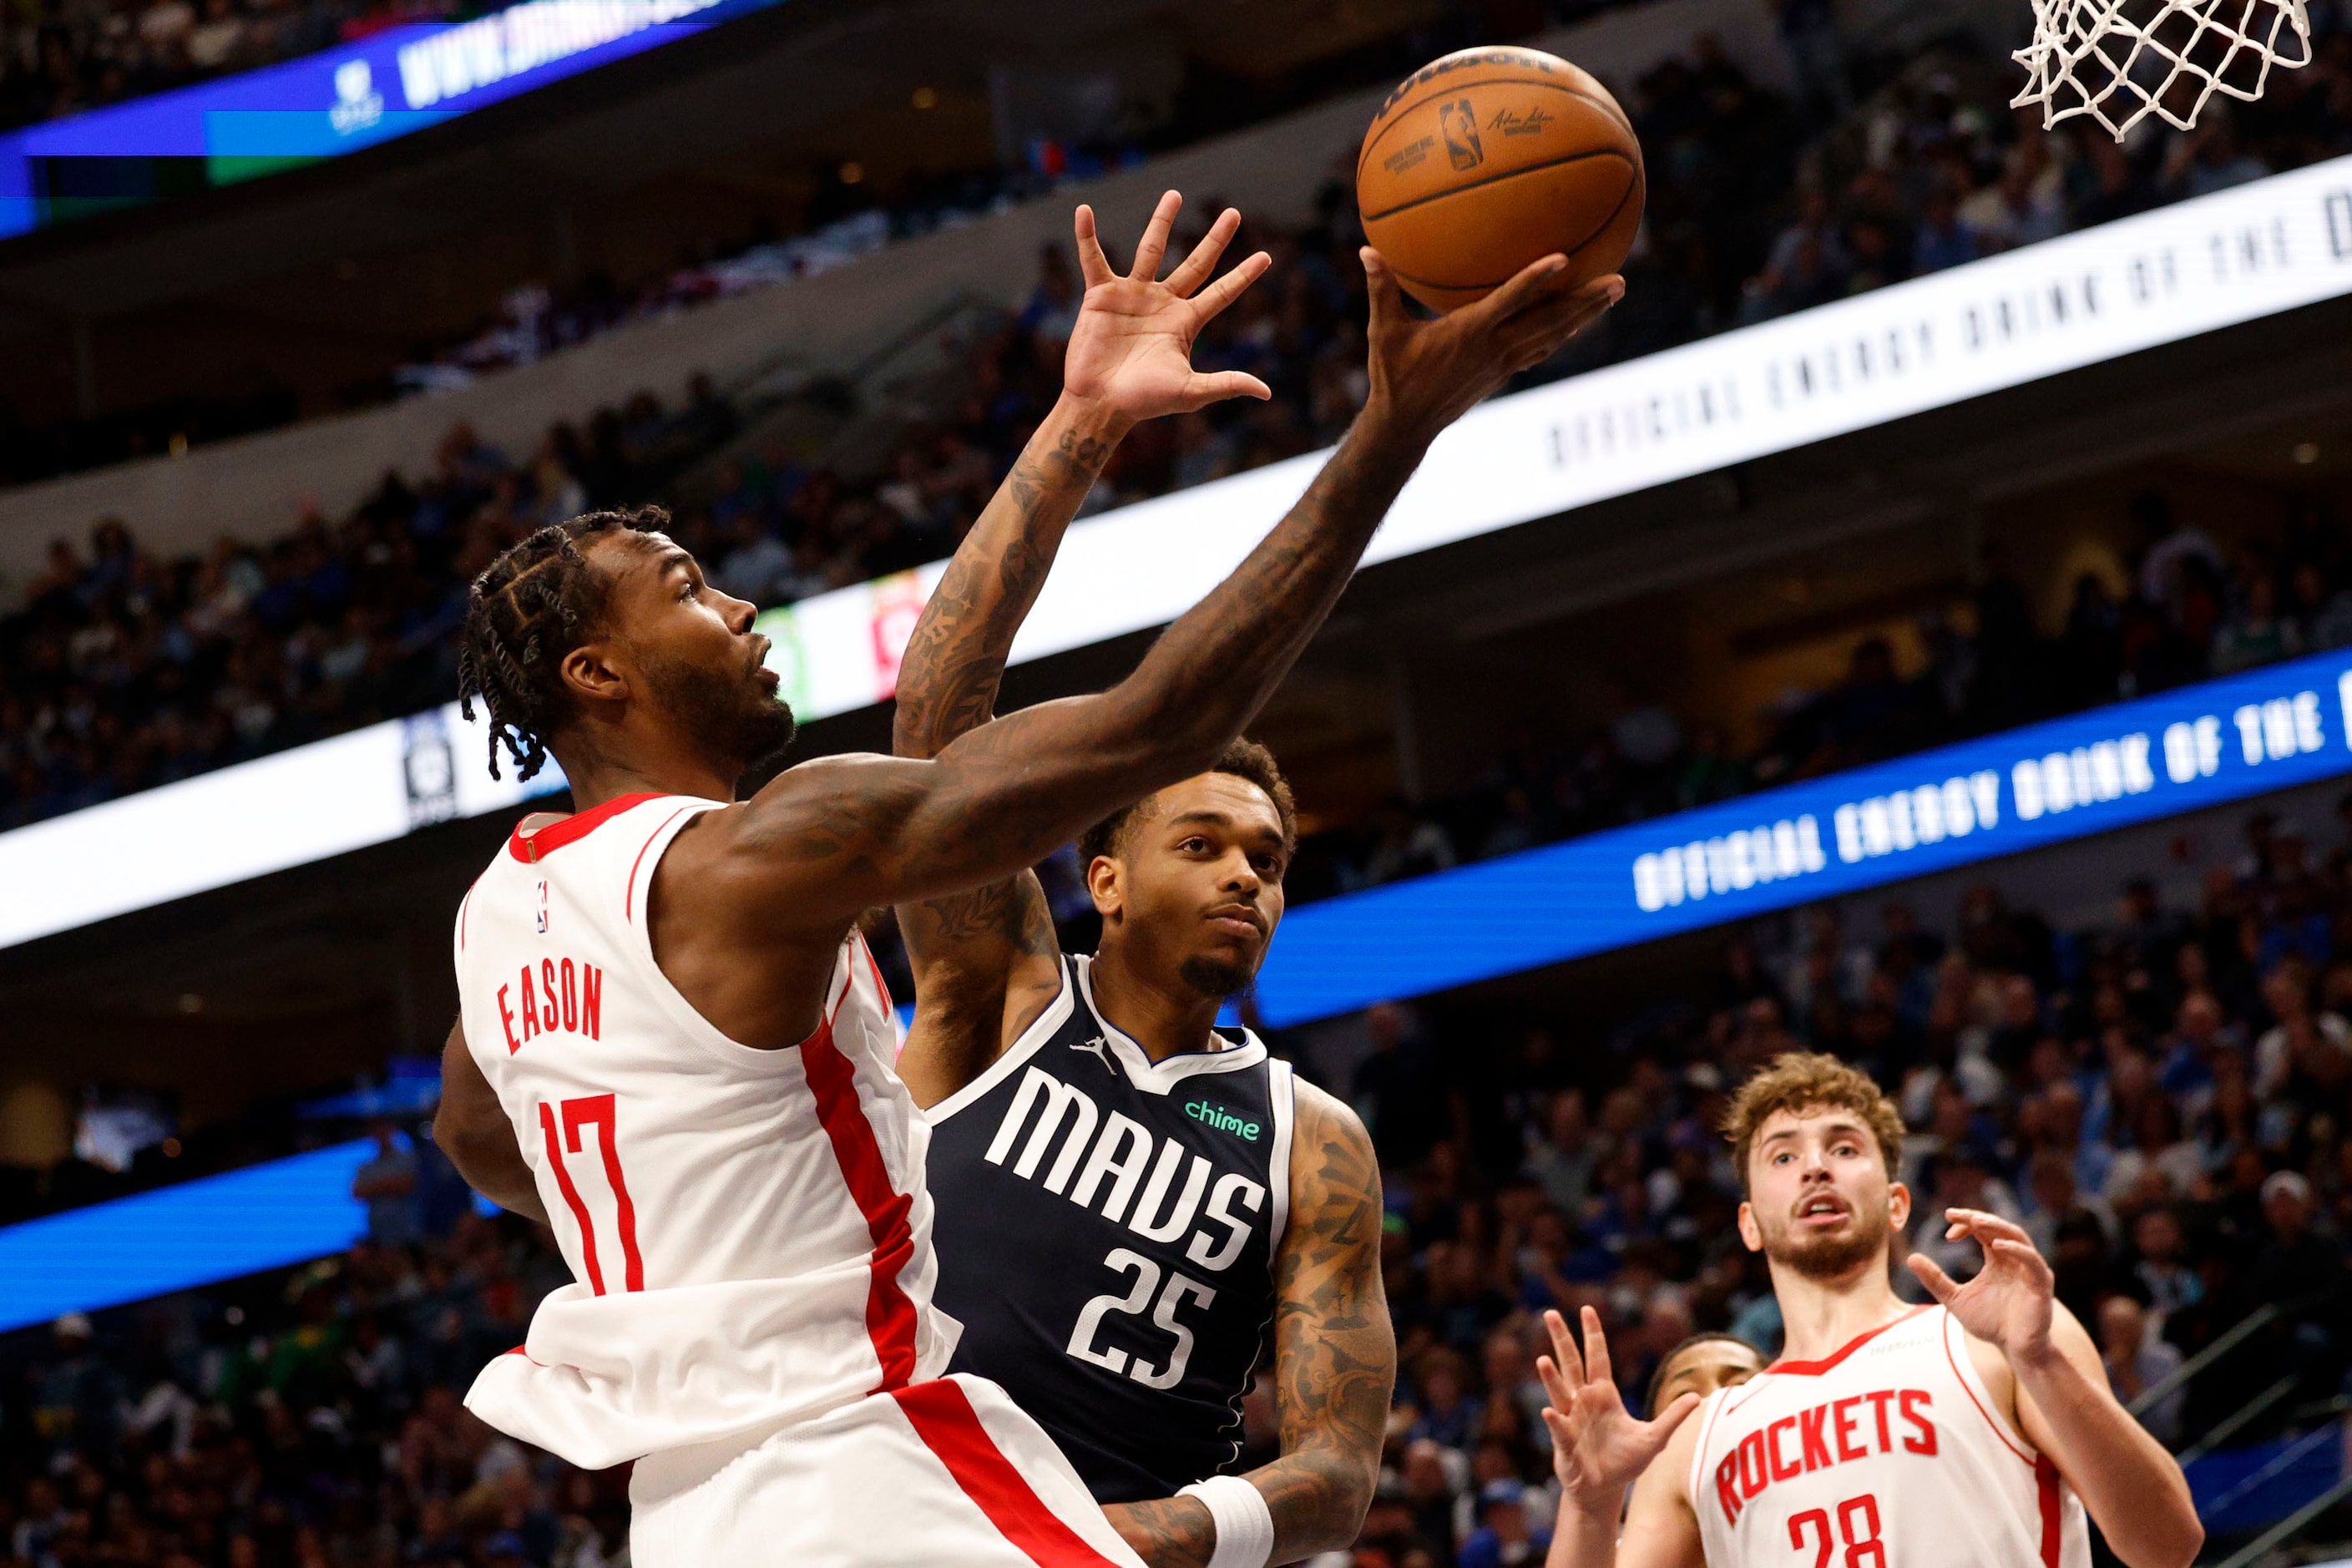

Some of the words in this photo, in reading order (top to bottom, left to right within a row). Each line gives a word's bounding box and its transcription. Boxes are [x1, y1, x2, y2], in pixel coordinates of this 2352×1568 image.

[1547, 378, 1742, 468] OFFICIAL
[1767, 320, 1935, 408] ENERGY
[1962, 271, 2106, 352] DRINK
[2128, 245, 2179, 306] OF
[2208, 215, 2294, 285] THE
[1633, 814, 1825, 912] OFFICIAL
[1834, 770, 1999, 863] ENERGY
[2012, 732, 2153, 821] DRINK
[2163, 715, 2223, 784] OF
[2233, 690, 2325, 766] THE
[497, 957, 602, 1056] EASON
[984, 1065, 1266, 1271] MAVS
[1185, 1100, 1260, 1141] chime
[539, 1094, 645, 1297] 17
[1066, 1247, 1216, 1389] 25
[1716, 1388, 1938, 1529] ROCKETS
[1788, 1494, 1887, 1568] 28
